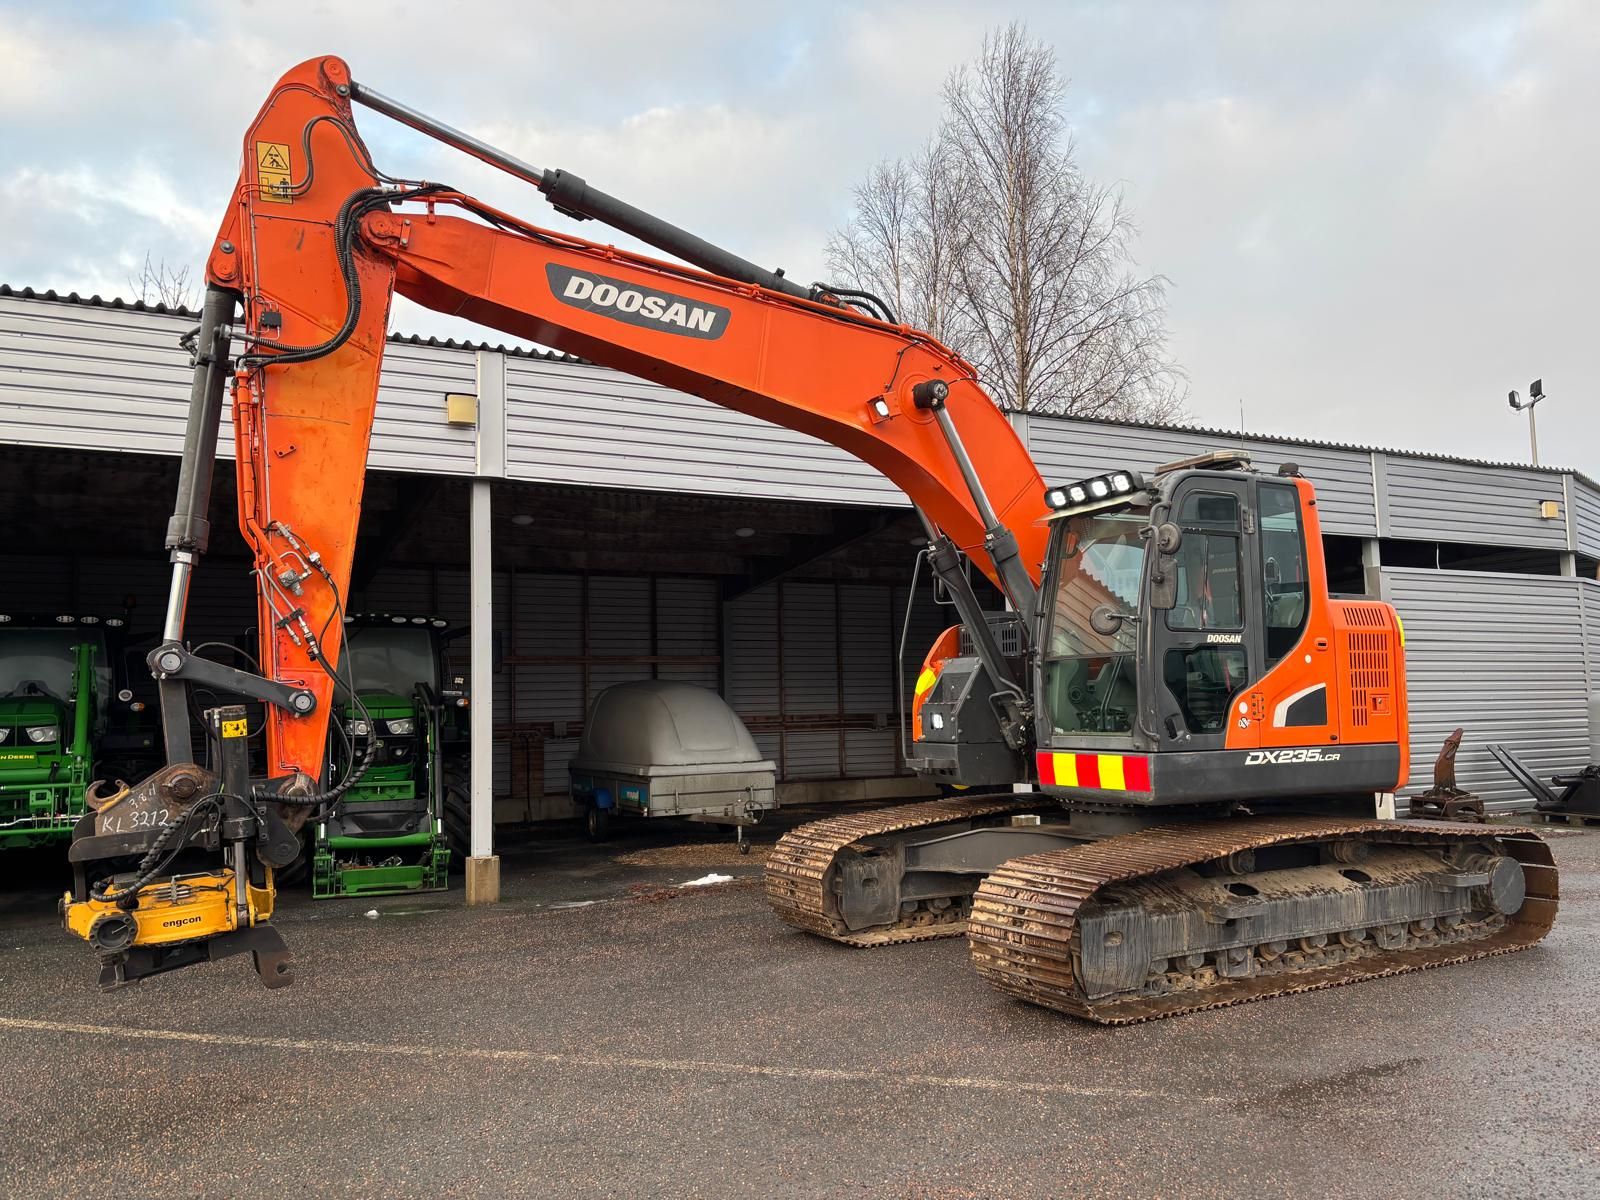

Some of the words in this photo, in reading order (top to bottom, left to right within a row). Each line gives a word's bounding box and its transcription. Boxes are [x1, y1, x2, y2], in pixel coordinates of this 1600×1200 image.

[563, 275, 716, 333] DOOSAN
[1207, 634, 1242, 643] DOOSAN
[162, 915, 202, 928] engcon
